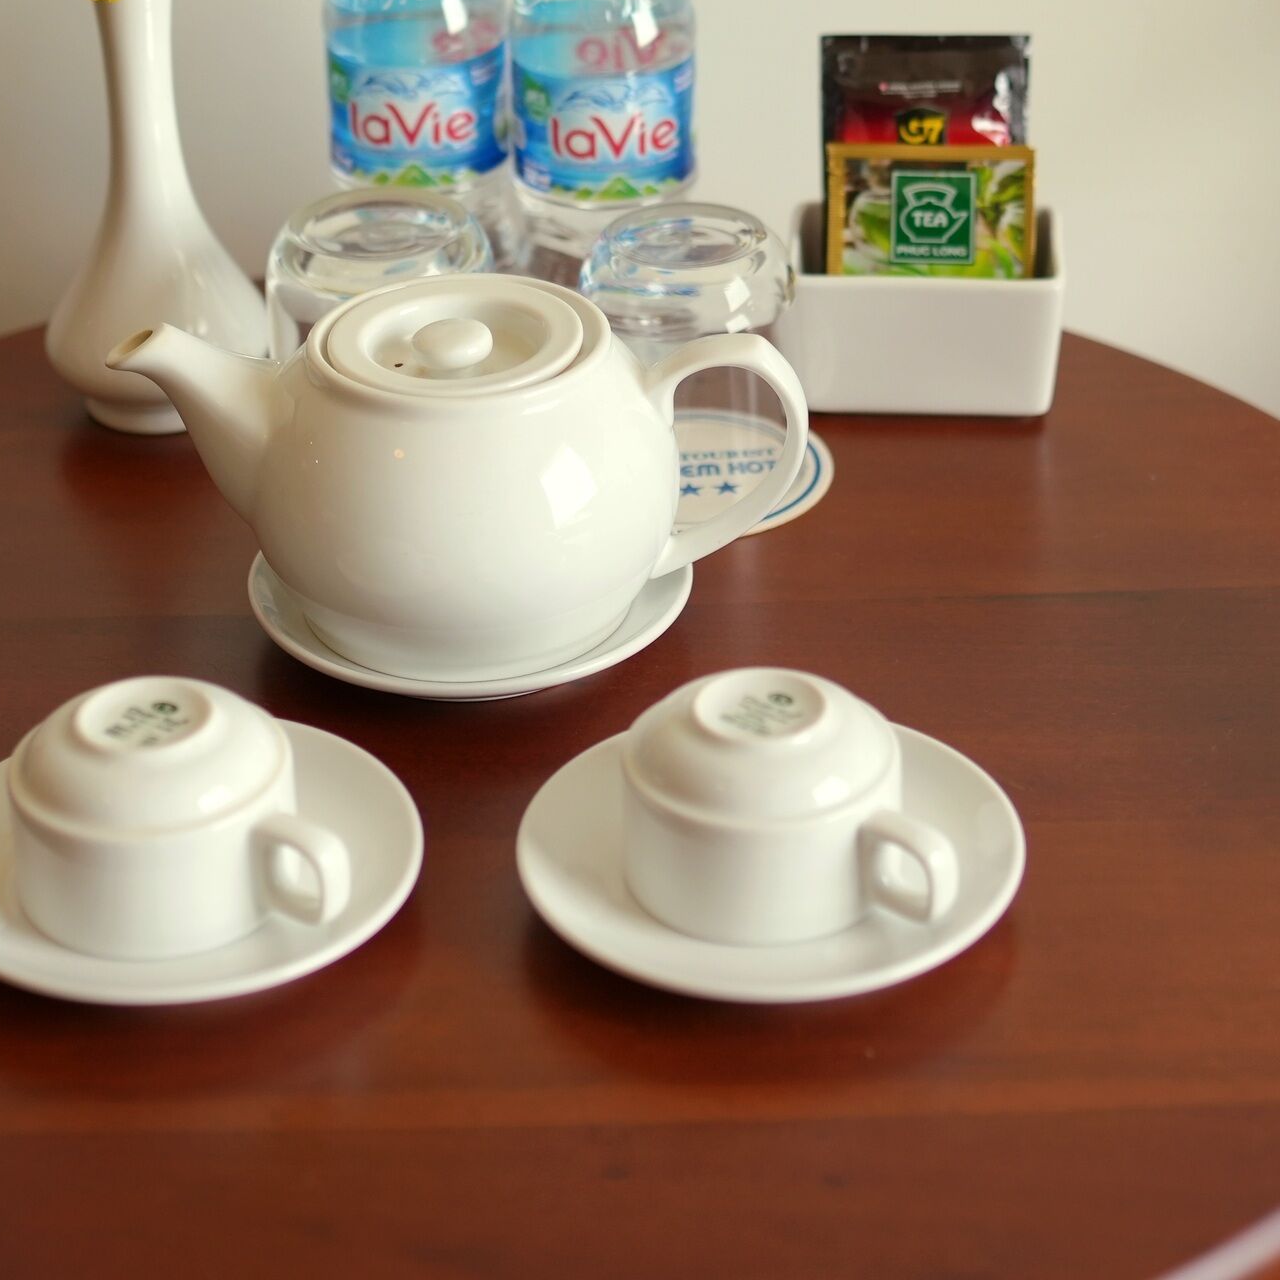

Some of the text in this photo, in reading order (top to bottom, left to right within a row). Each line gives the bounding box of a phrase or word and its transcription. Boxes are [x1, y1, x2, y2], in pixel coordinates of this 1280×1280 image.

[350, 101, 477, 147] laVie
[551, 112, 678, 160] laVie
[899, 117, 943, 145] G7
[911, 210, 949, 228] TEA
